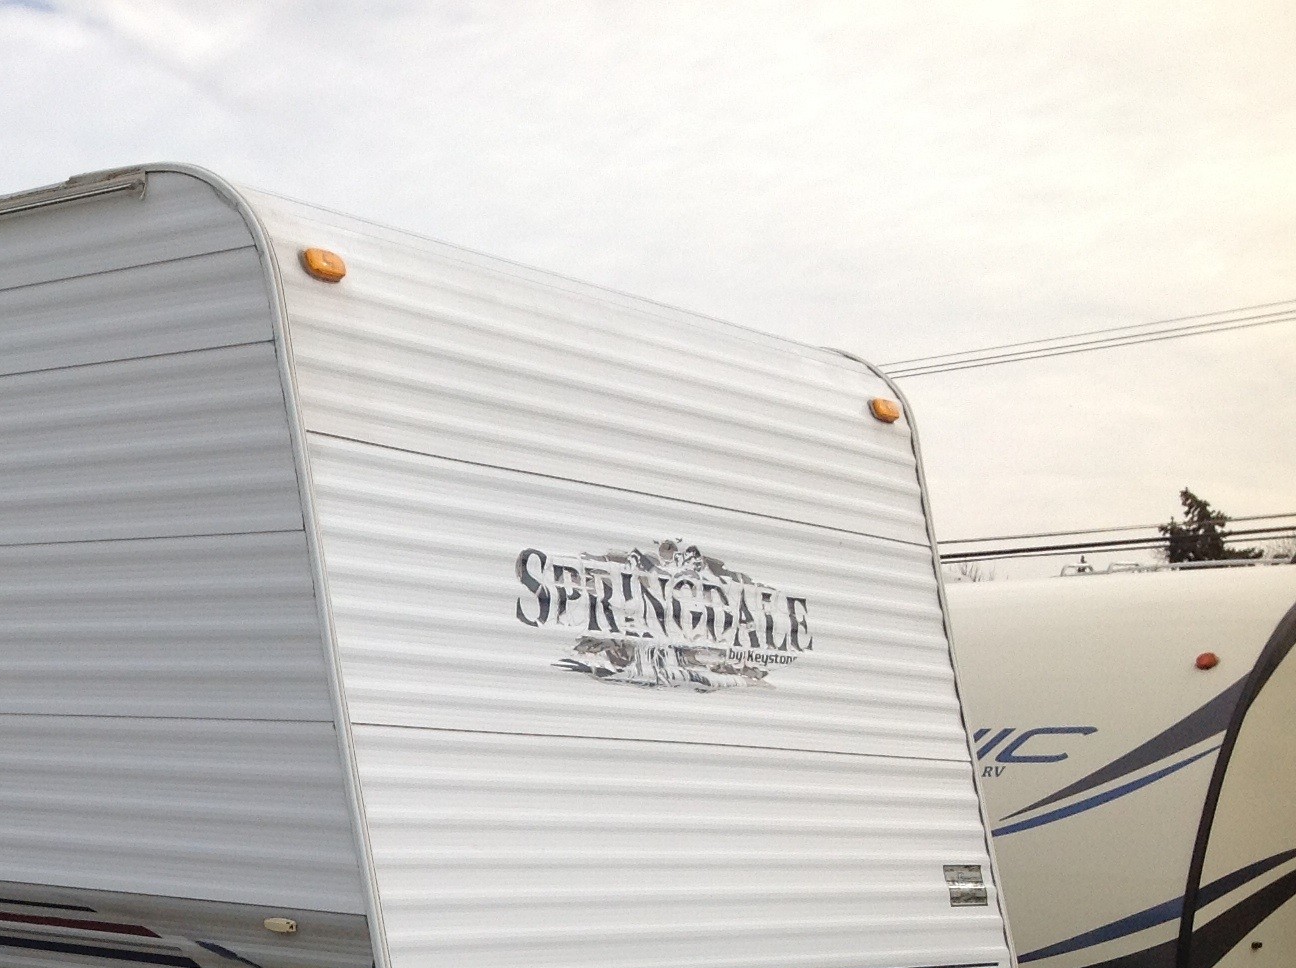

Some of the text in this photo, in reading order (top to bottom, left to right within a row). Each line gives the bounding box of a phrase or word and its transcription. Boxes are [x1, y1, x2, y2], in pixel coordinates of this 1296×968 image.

[515, 548, 813, 651] SPRINGDALE
[728, 648, 745, 665] by
[982, 766, 1006, 777] RV
